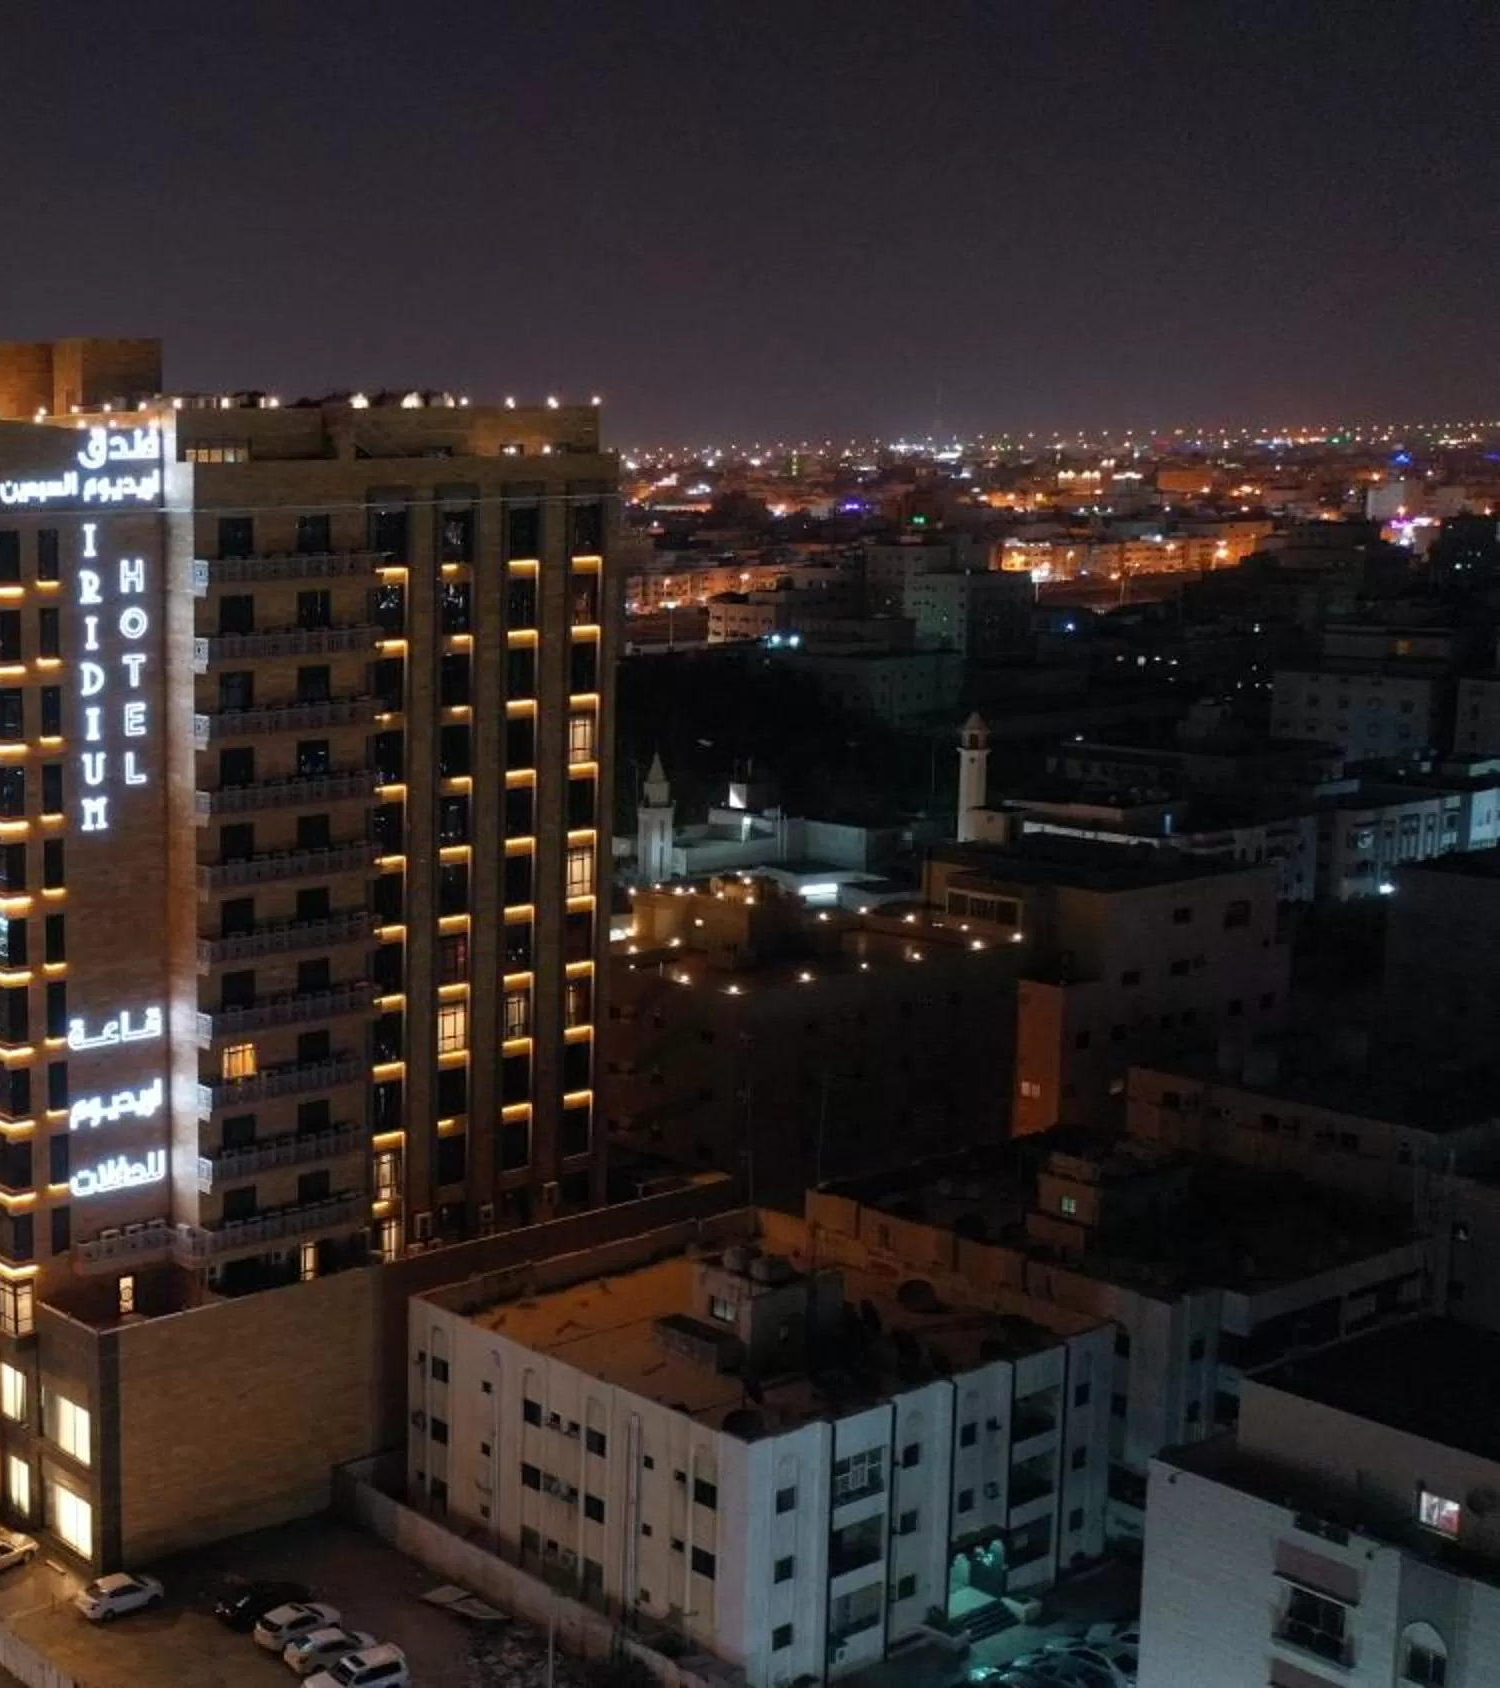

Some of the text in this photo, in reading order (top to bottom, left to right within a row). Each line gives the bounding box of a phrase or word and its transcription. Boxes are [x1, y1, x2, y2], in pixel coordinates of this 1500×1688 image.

[77, 427, 161, 470] فندق
[78, 522, 109, 832] IRIDIUM
[118, 557, 149, 786] HOTEL
[67, 1006, 163, 1051] قاعة
[70, 1149, 167, 1198] للحفلات
